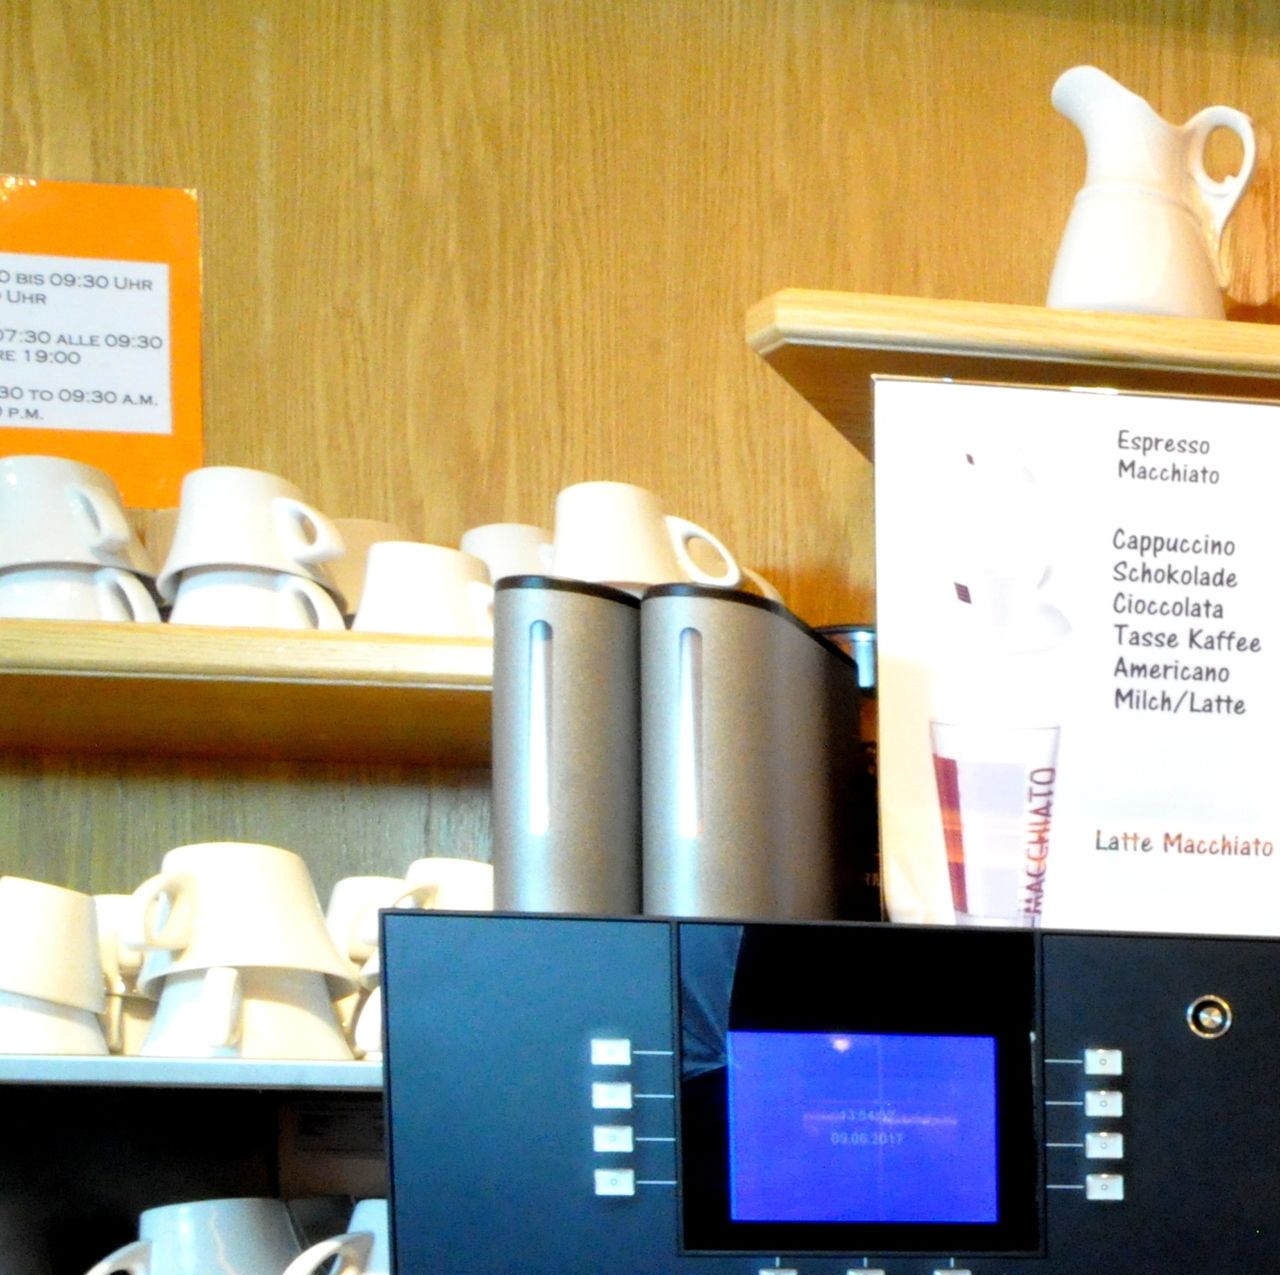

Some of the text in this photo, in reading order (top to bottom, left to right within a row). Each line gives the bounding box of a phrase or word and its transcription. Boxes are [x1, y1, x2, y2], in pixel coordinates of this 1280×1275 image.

[16, 273, 45, 286] BIS
[50, 273, 109, 289] 09:30
[56, 334, 100, 347] ALLE
[104, 334, 163, 349] 09:30
[24, 350, 81, 364] 19:00
[58, 388, 117, 404] 09:30
[1117, 429, 1211, 457] Espresso
[1118, 459, 1220, 485] Macchiato
[1112, 528, 1236, 558] Cappuccino
[1112, 560, 1238, 588] Schokolade
[1112, 592, 1224, 619] Cioccolata
[1113, 624, 1262, 653] Tasse Kaffee
[1113, 656, 1230, 683] Americano
[1114, 687, 1247, 715] Milch/Latte
[1095, 829, 1275, 857] Latte Macchiato
